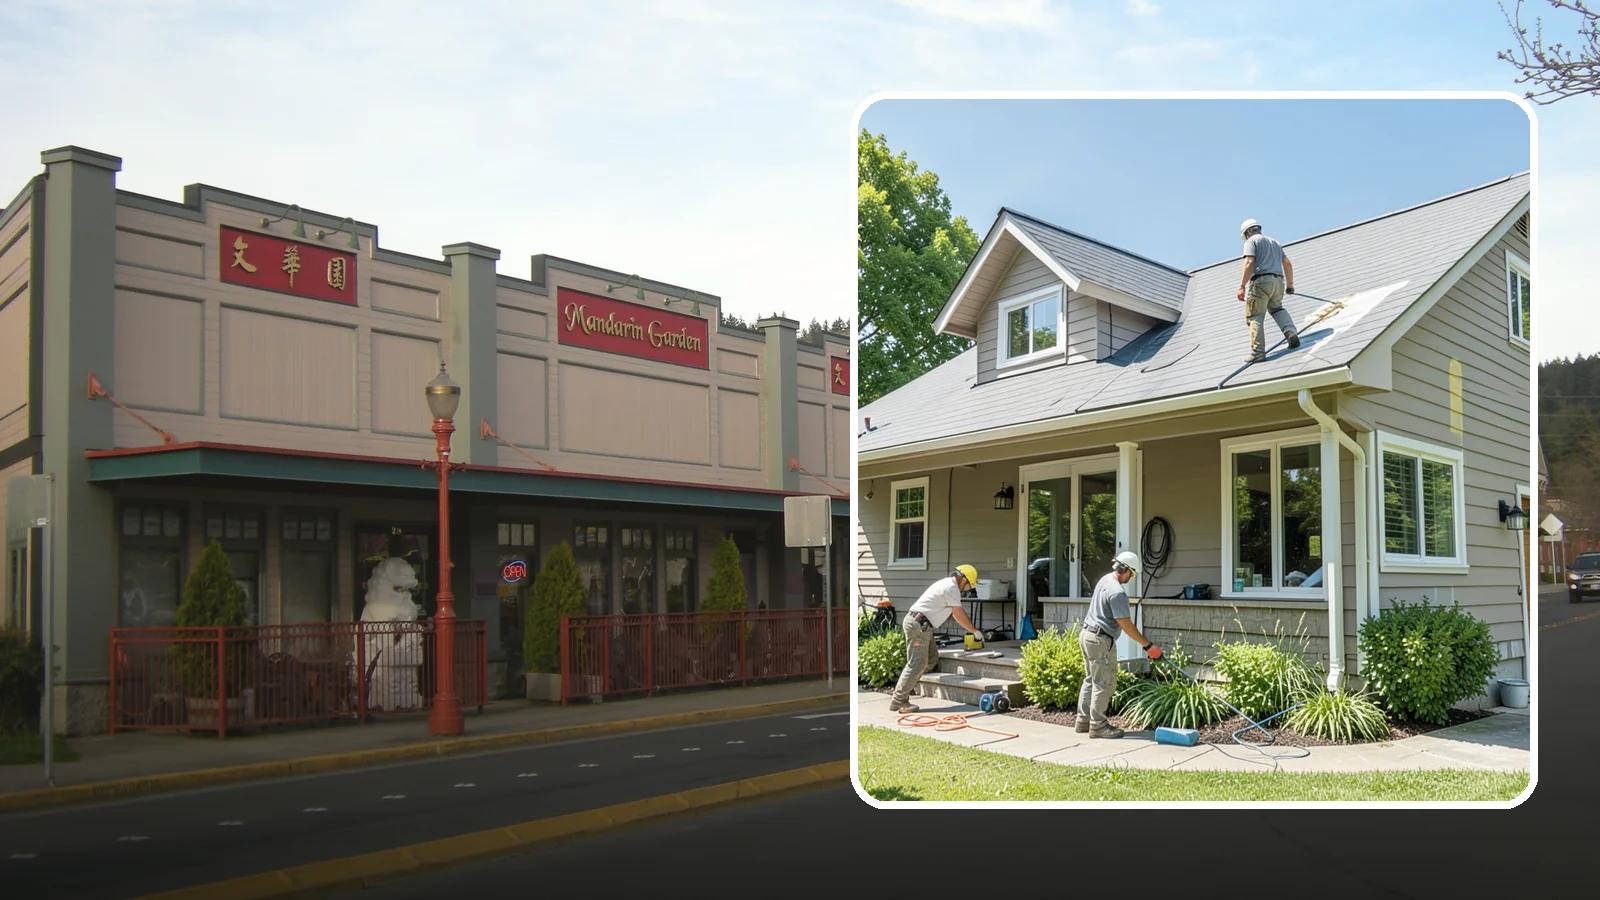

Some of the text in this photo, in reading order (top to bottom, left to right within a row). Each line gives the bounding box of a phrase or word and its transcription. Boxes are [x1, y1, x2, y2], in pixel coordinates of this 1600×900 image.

[231, 236, 346, 290] 文華園
[565, 302, 702, 352] Mandarin Garden
[503, 565, 527, 578] OPEN
